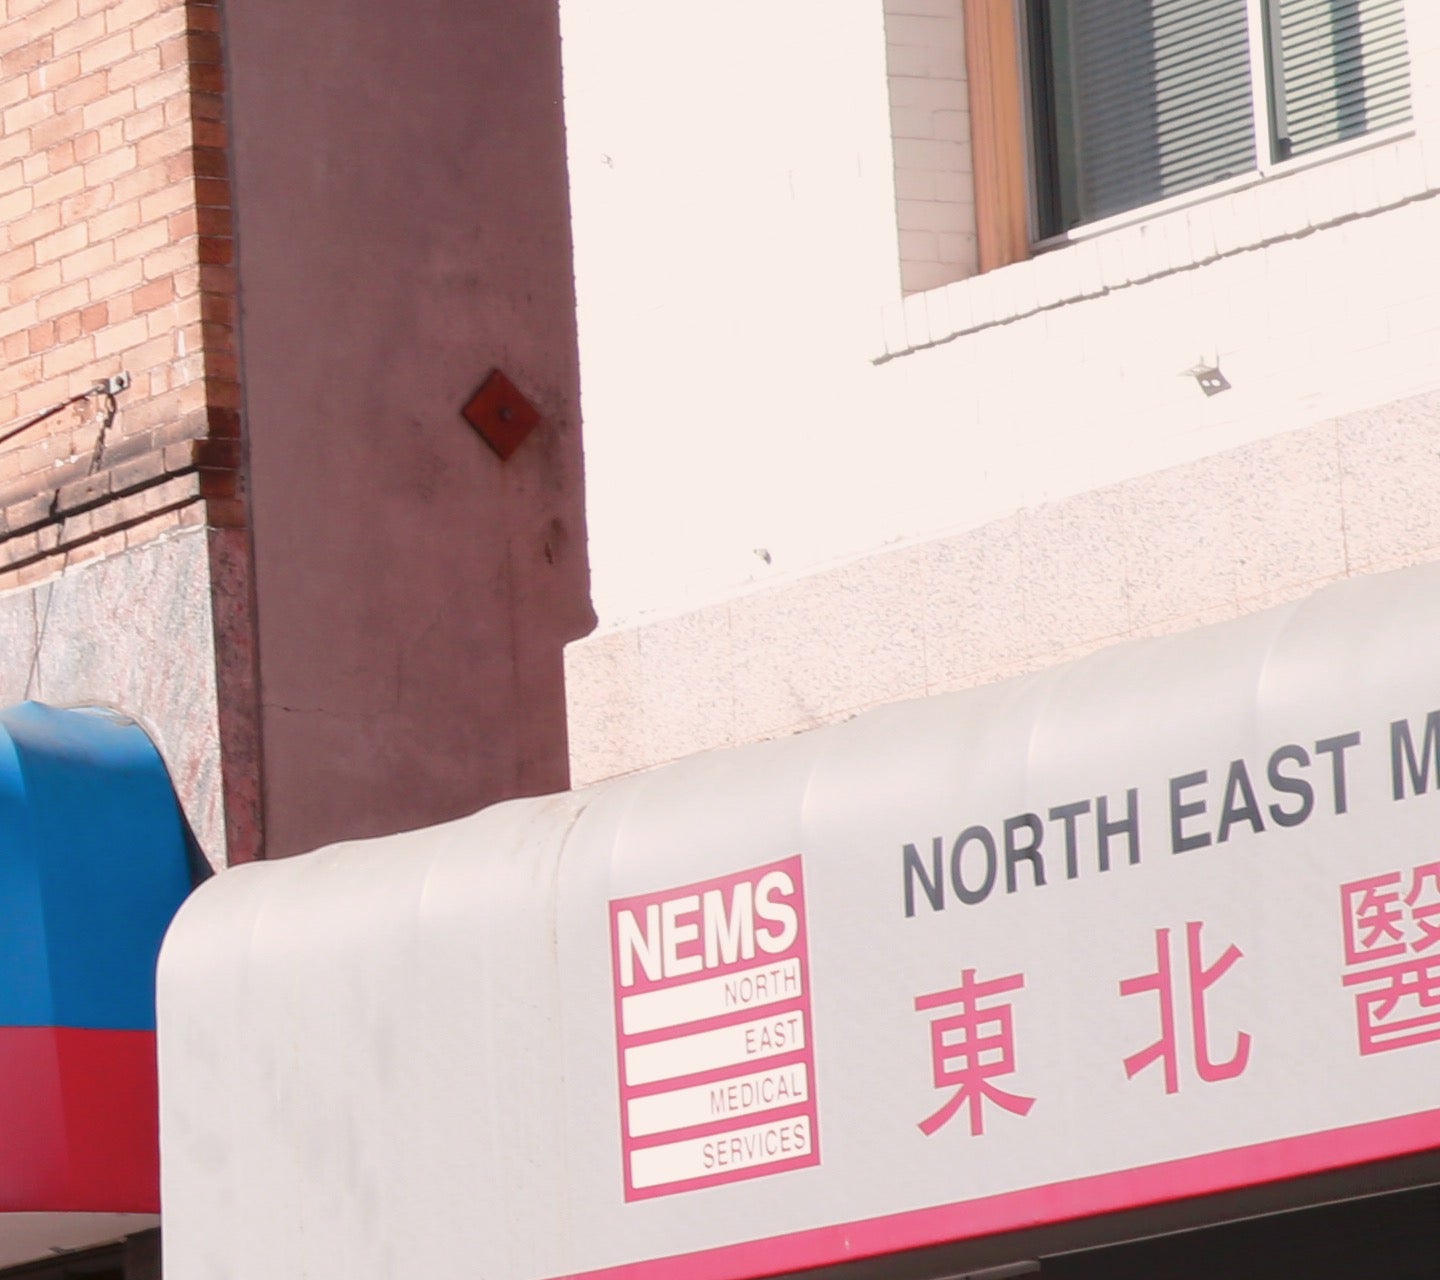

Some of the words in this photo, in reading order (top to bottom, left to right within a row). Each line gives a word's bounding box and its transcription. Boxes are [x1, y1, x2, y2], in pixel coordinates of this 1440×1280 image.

[902, 786, 1142, 919] NORTH
[1168, 731, 1362, 856] EAST
[618, 870, 800, 988] NEMS
[723, 960, 799, 1008] NORTH
[744, 1016, 800, 1057] EAST
[709, 1069, 804, 1118] MEDICAL
[701, 1122, 808, 1173] SERVICES
